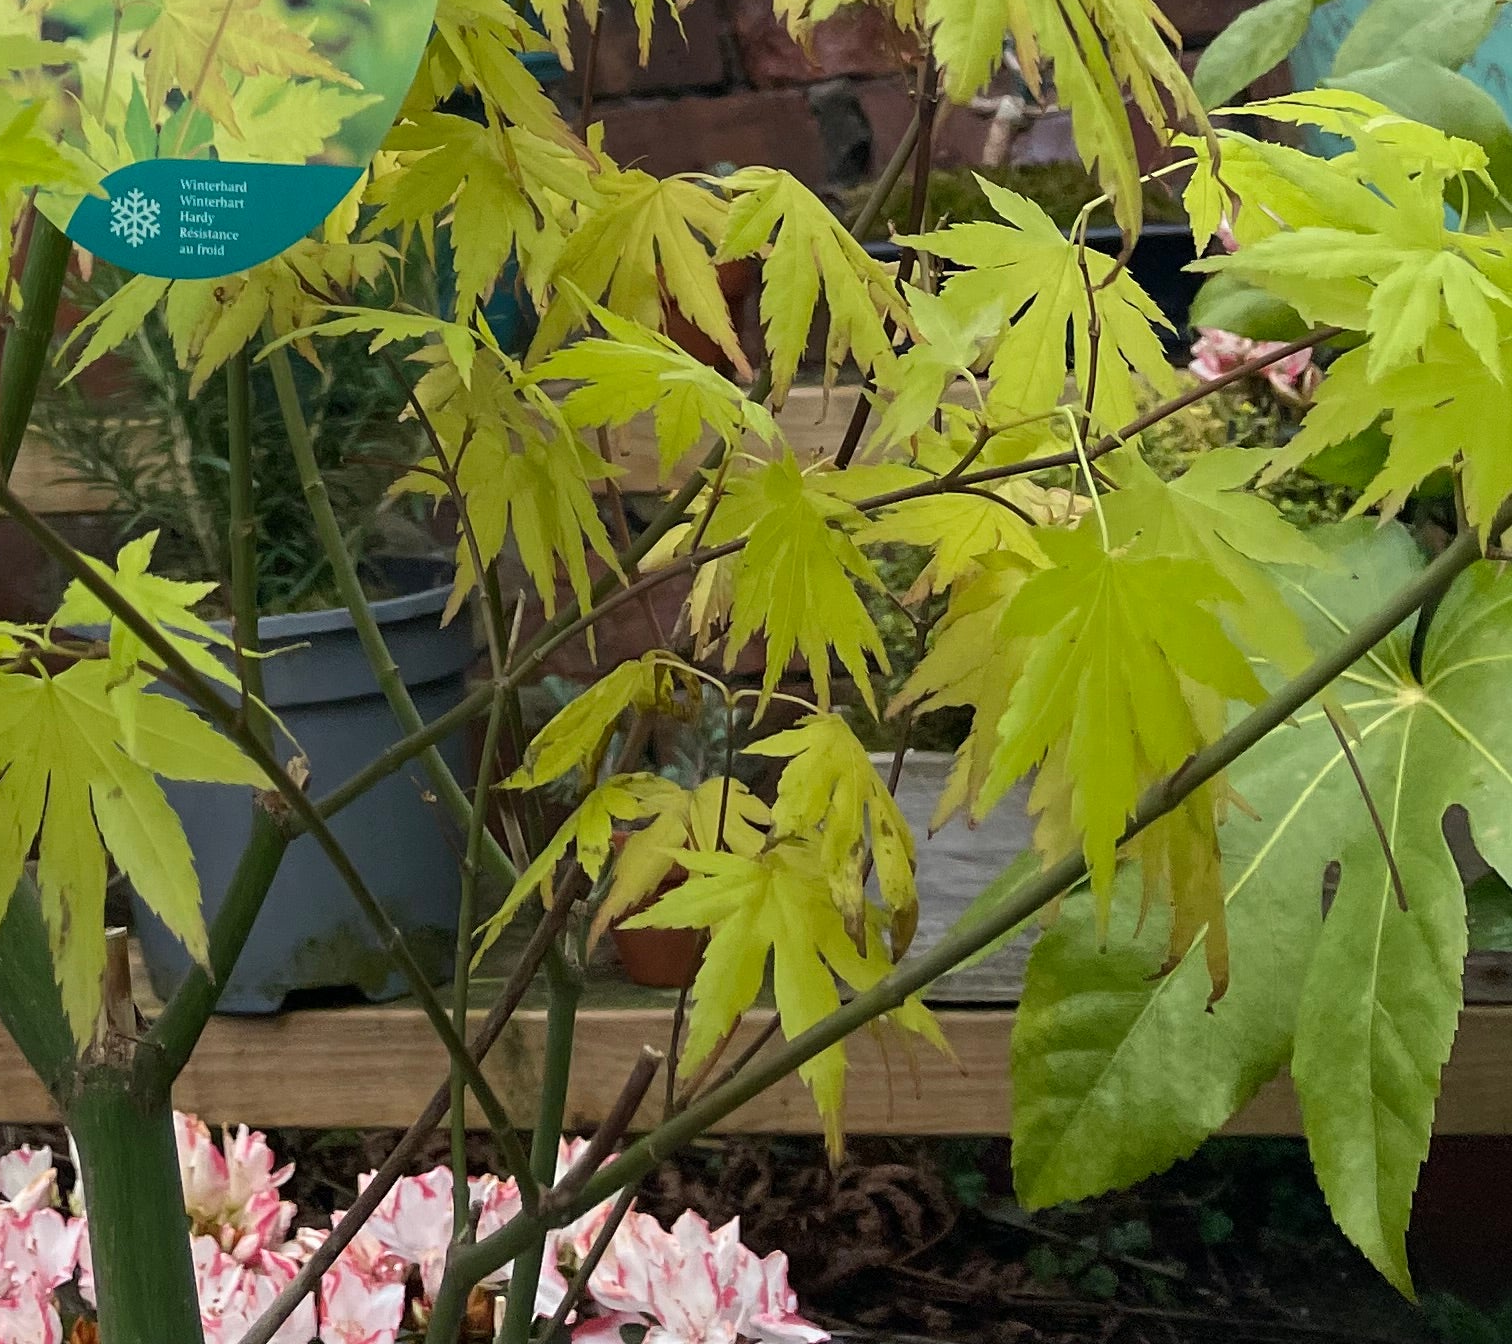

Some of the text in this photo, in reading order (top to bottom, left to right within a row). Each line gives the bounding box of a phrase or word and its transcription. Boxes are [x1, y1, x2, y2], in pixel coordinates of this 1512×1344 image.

[179, 178, 248, 193] Winterhard
[179, 194, 245, 209] Winterhart
[179, 210, 215, 226] Hardy
[179, 226, 240, 241] Résistance
[179, 243, 225, 256] au froid
